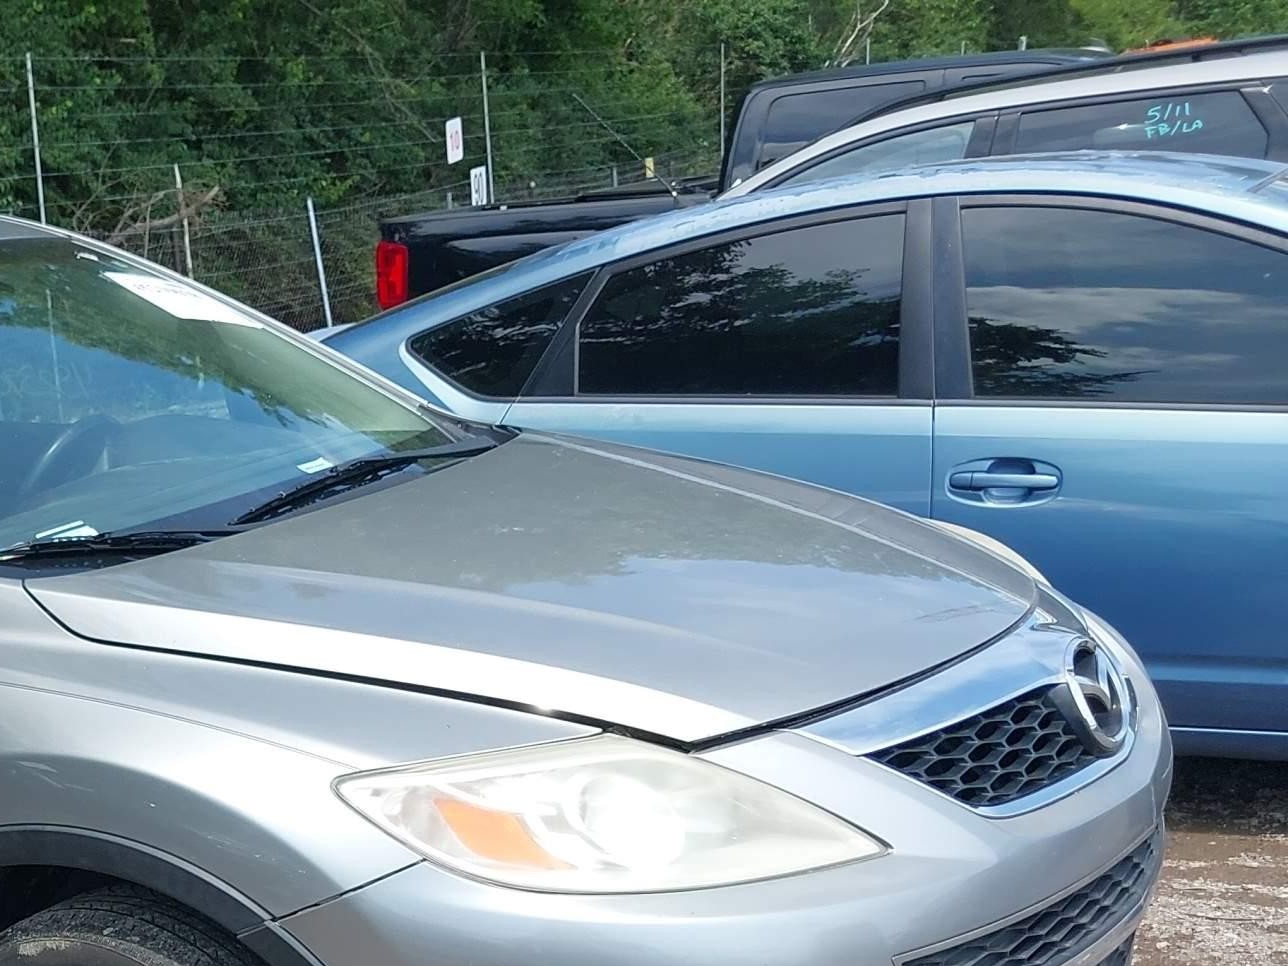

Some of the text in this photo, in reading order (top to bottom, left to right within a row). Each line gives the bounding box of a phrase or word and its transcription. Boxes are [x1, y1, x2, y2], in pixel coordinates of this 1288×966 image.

[1144, 102, 1191, 124] 5/11
[1144, 119, 1204, 139] FB/LA
[450, 130, 461, 153] 10
[473, 172, 485, 206] 90
